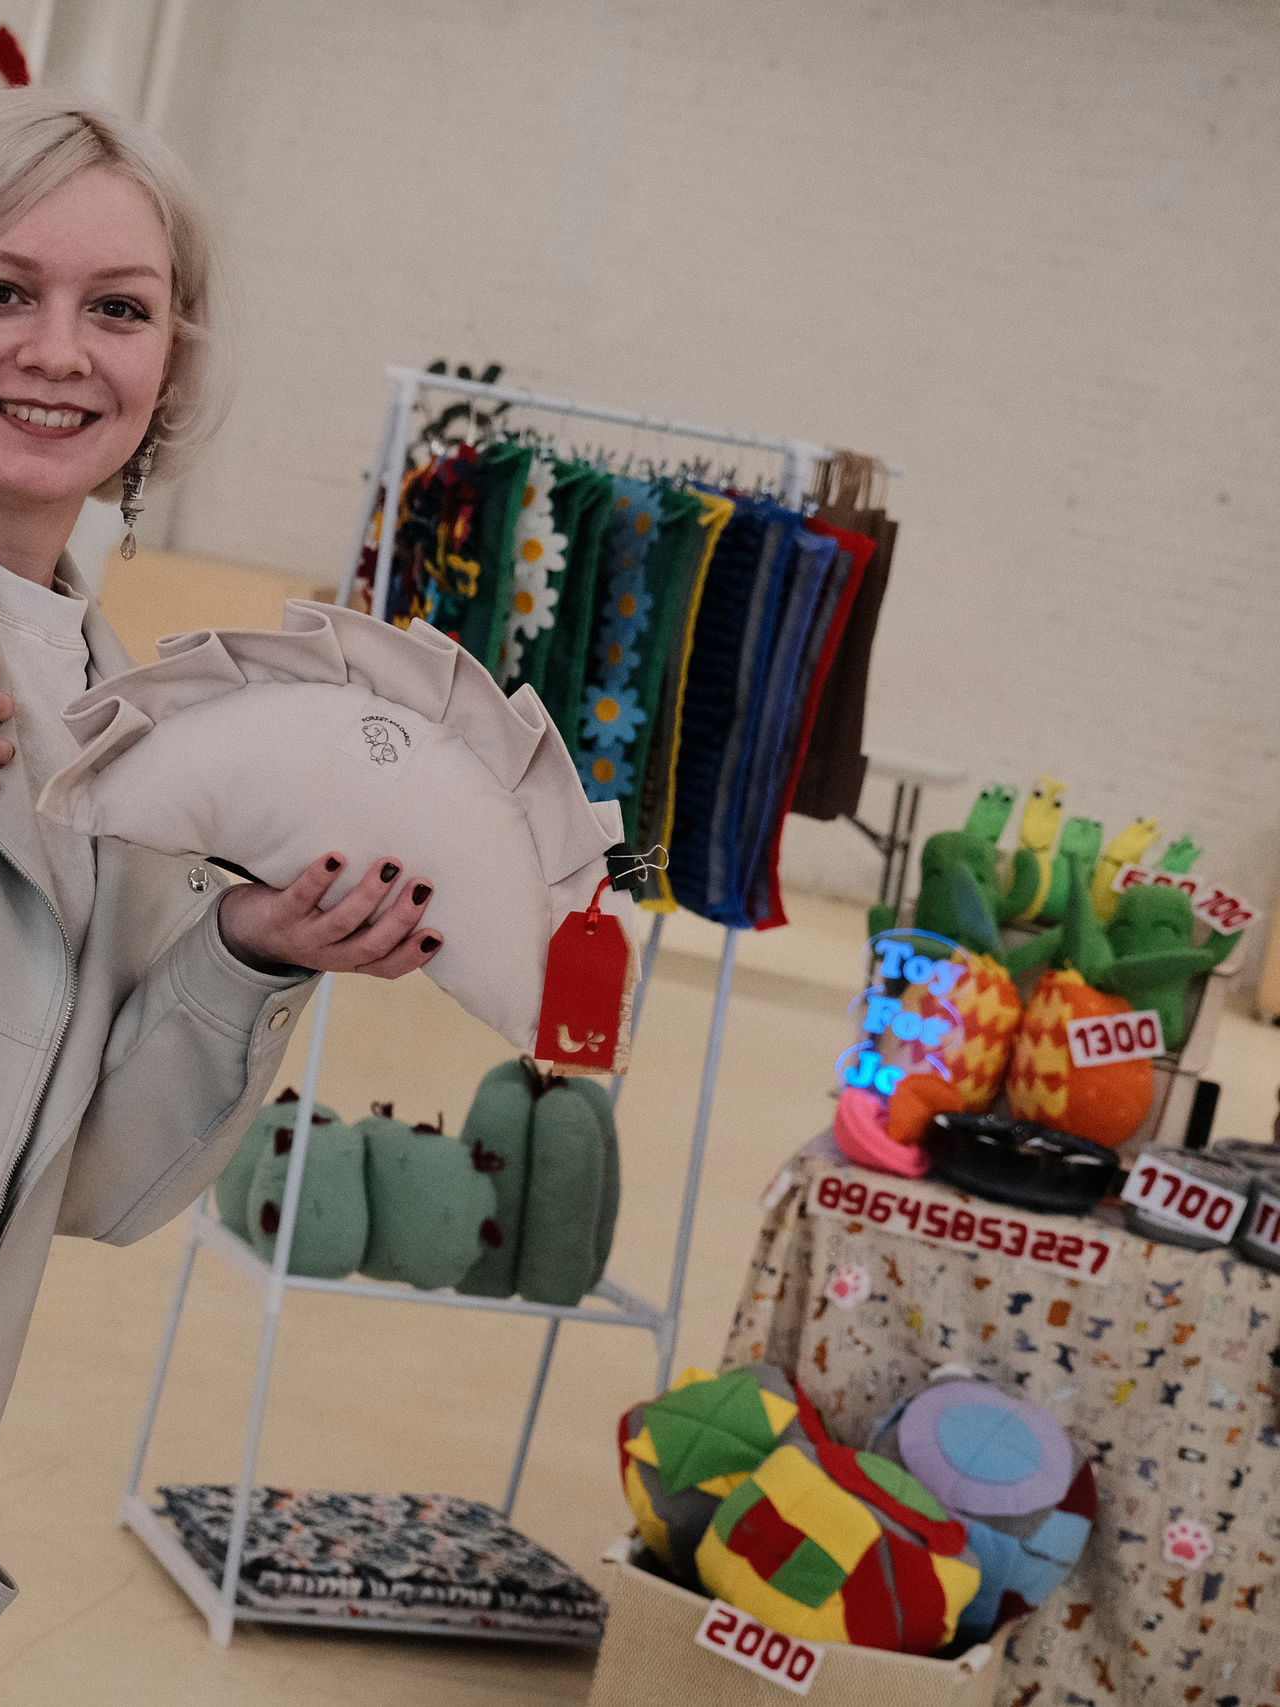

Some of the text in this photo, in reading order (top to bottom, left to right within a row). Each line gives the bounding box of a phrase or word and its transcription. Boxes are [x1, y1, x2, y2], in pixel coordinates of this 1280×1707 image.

[875, 938, 966, 997] Toy
[1075, 1017, 1157, 1058] 1300
[843, 1051, 906, 1095] Jo
[818, 1177, 1110, 1276] 89645853227
[1140, 1167, 1233, 1231] 1700
[705, 1608, 816, 1683] 2000
